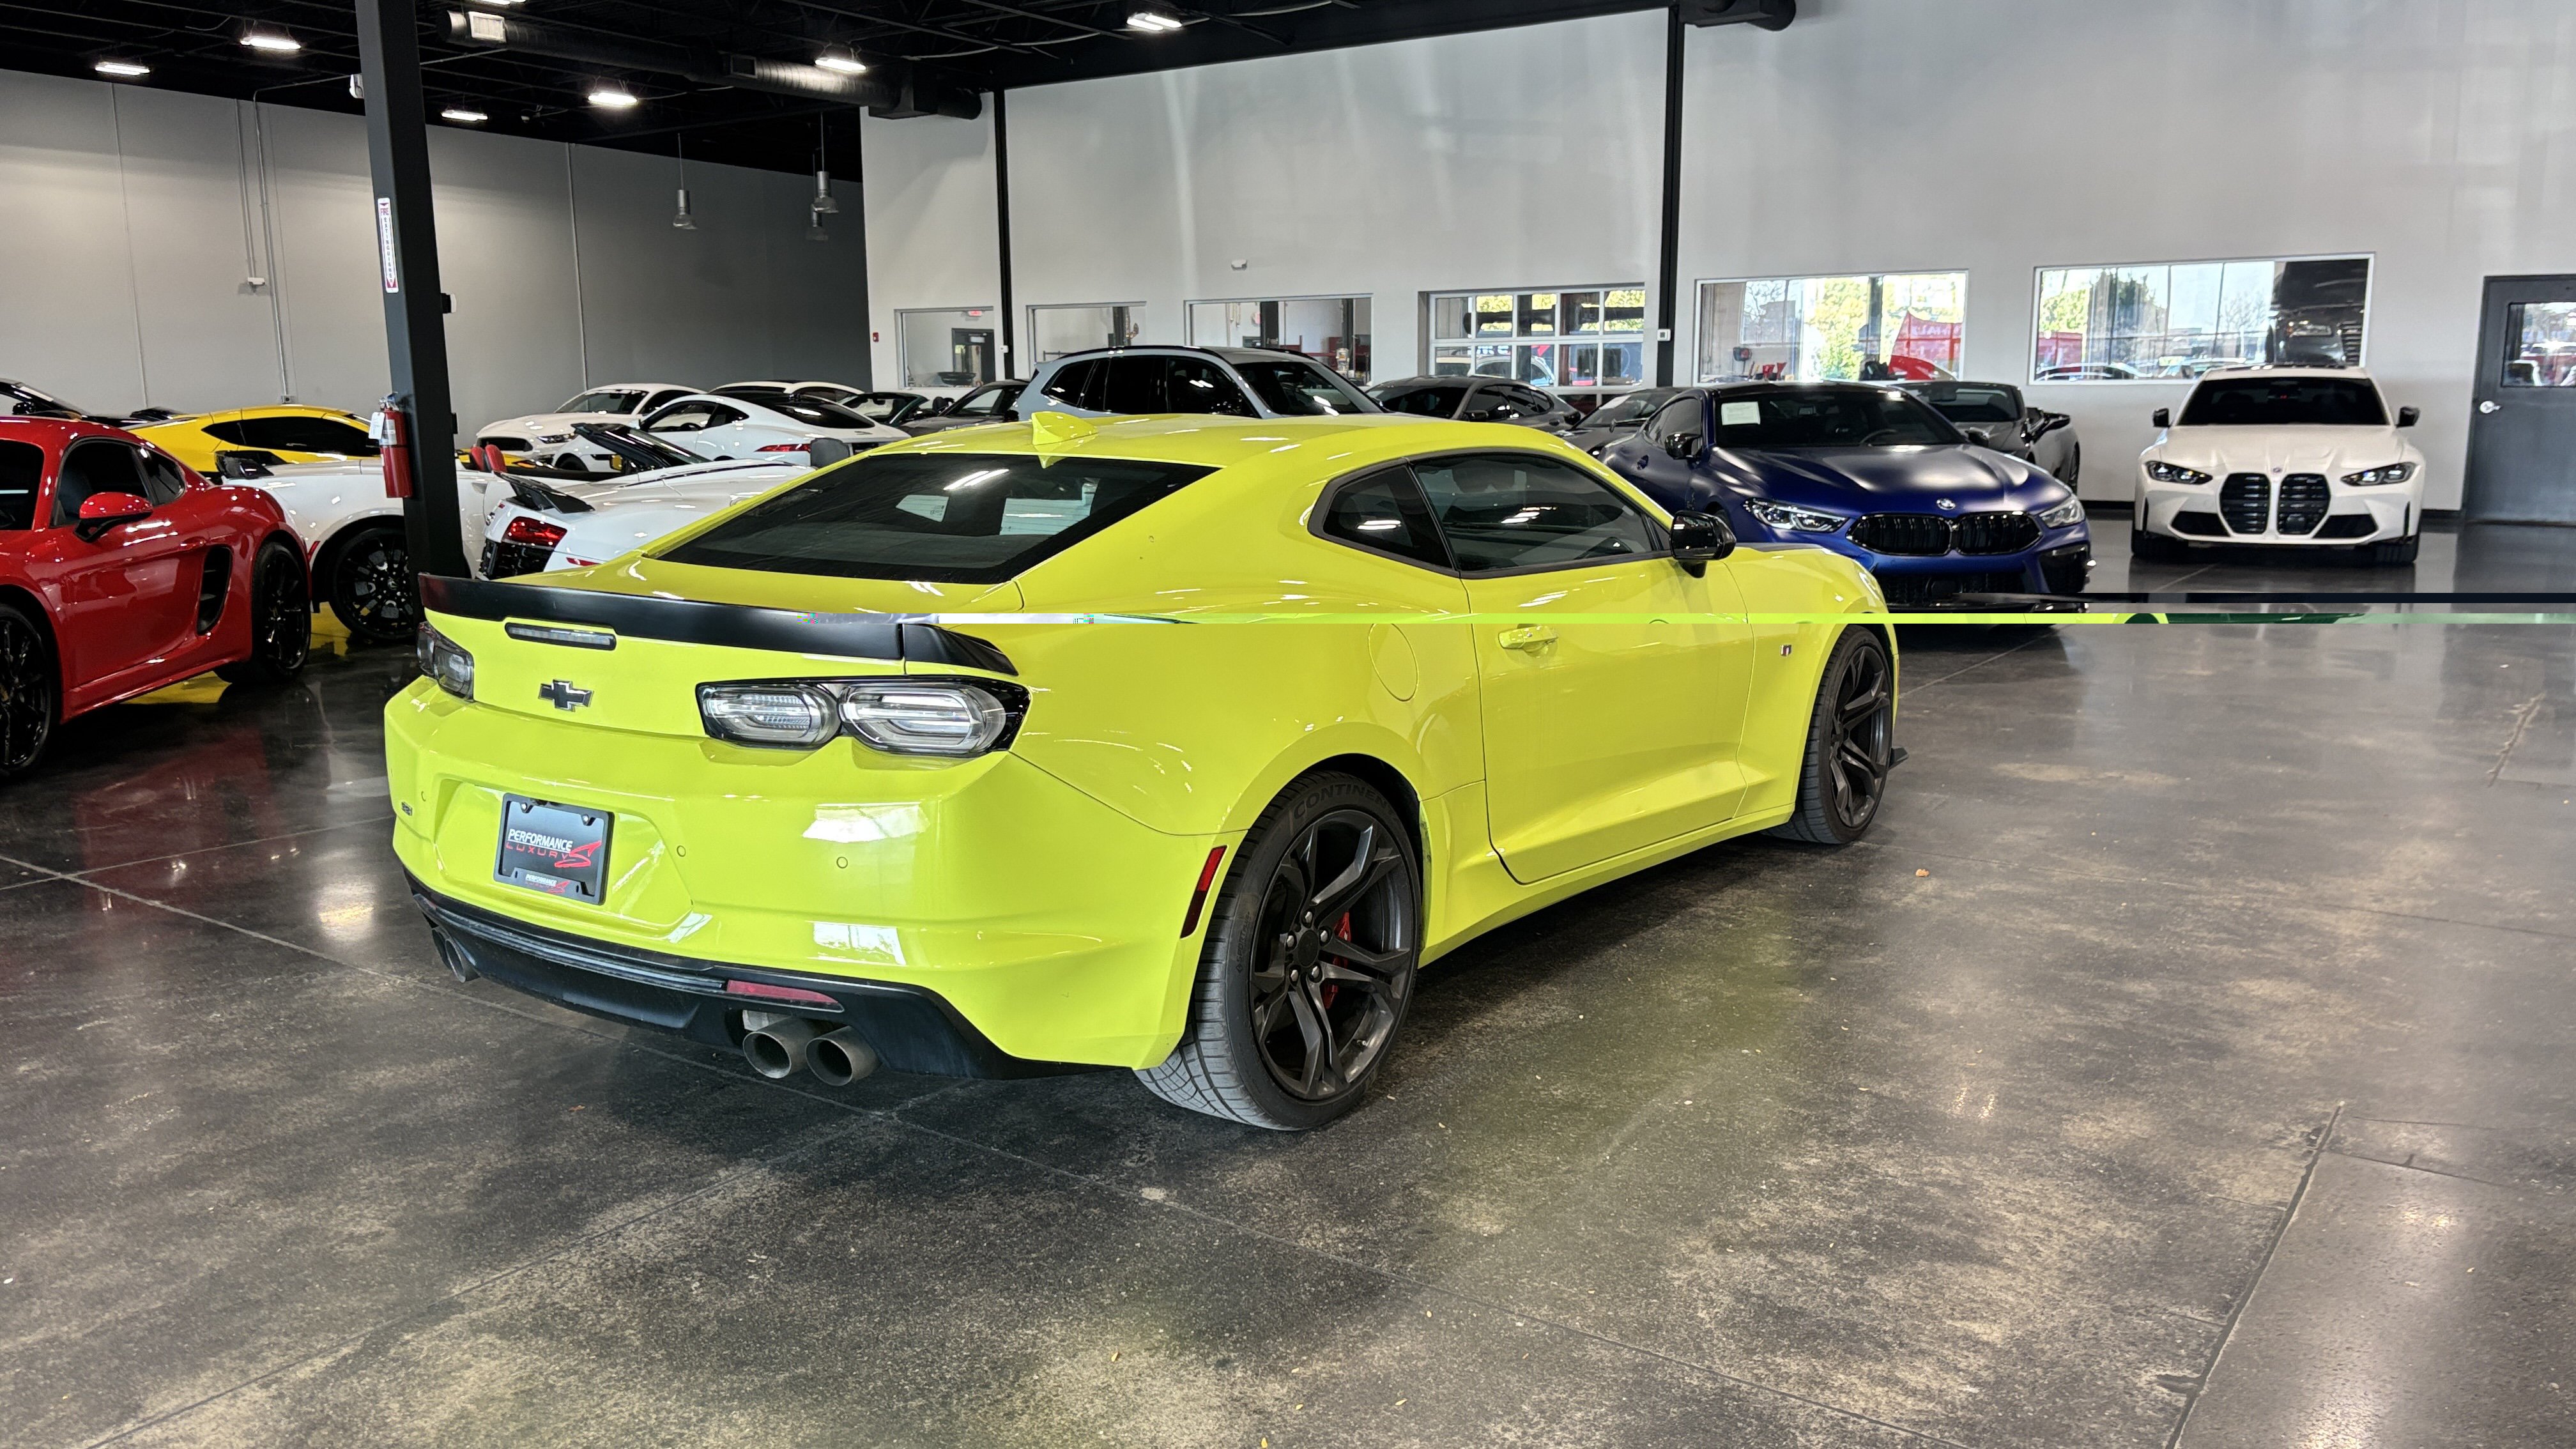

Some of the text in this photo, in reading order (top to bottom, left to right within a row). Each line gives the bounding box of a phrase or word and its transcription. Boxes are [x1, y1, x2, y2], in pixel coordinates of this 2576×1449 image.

[380, 208, 389, 216] FIRE
[508, 828, 573, 852] PERFORMANCE
[505, 841, 569, 859] LUXURY
